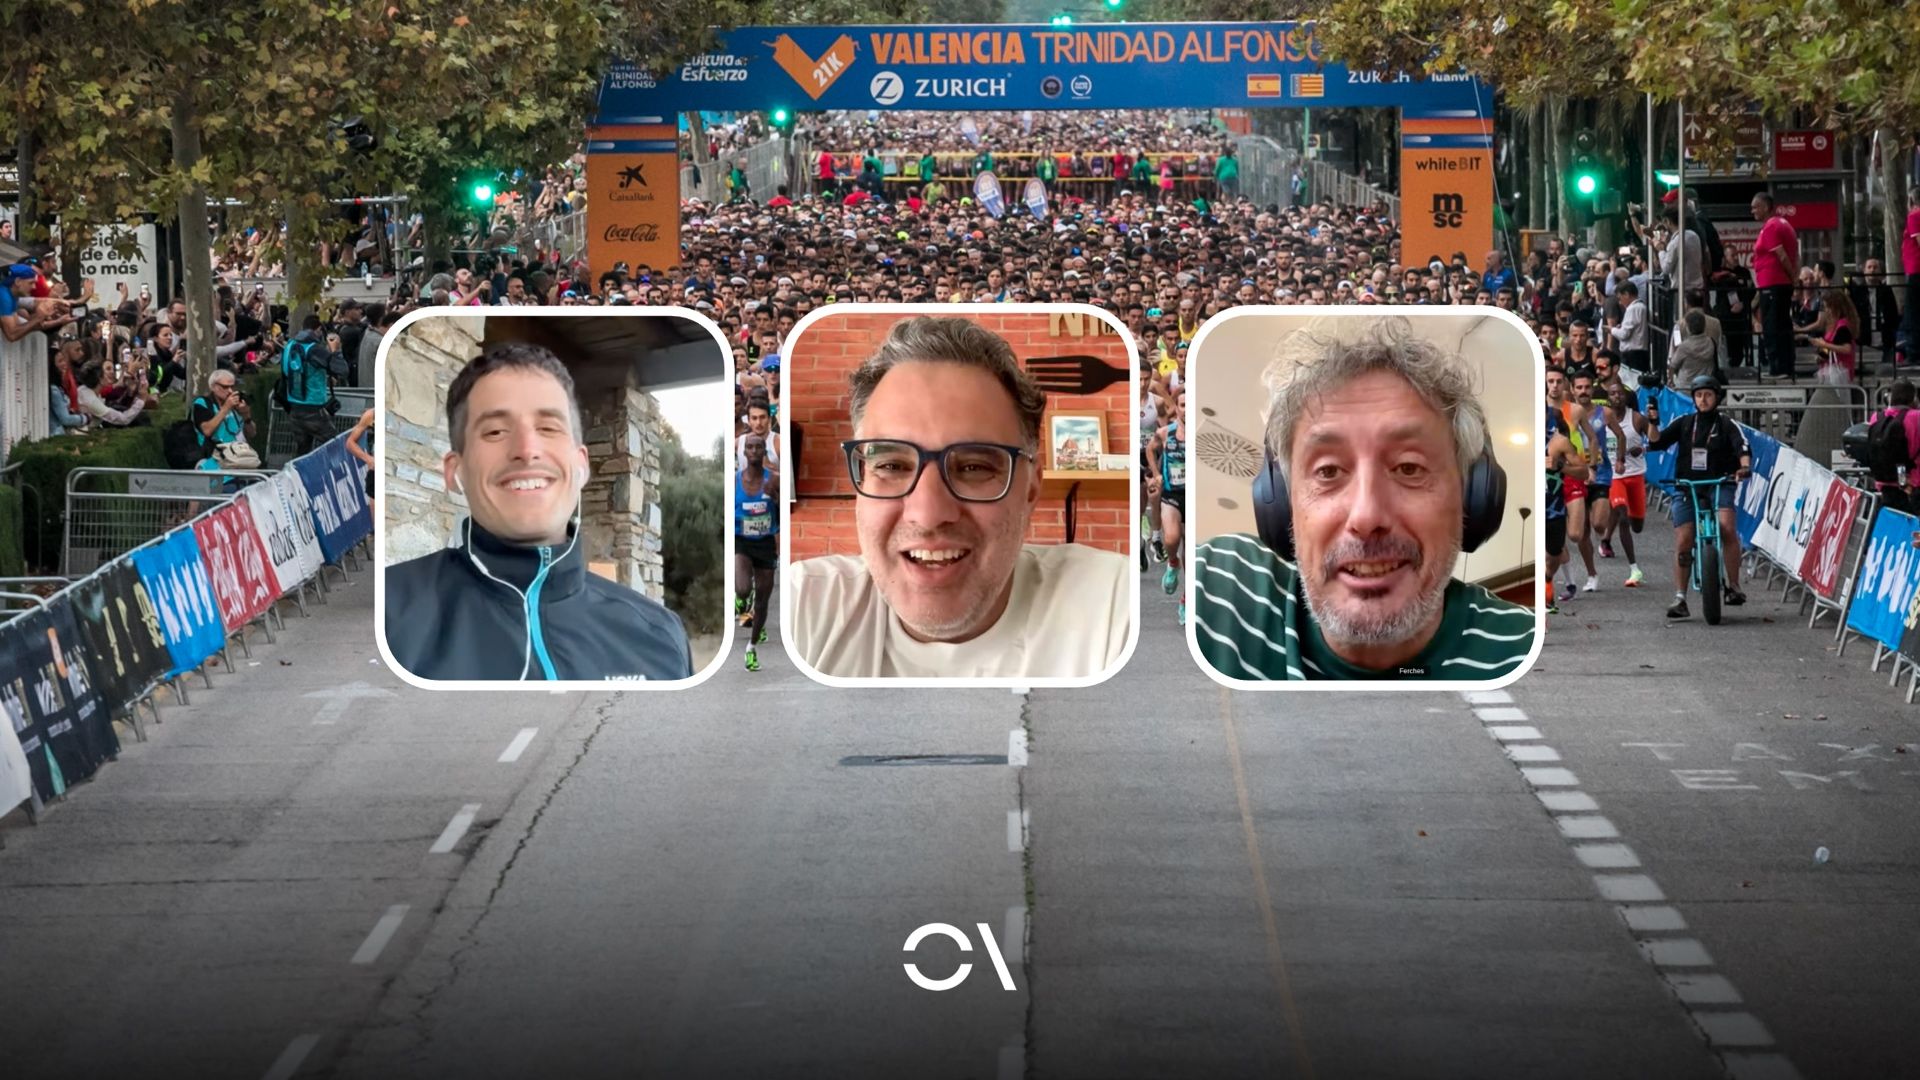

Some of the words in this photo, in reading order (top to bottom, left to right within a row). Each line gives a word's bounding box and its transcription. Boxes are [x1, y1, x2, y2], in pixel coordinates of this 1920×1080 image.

[870, 33, 1025, 64] VALENCIA
[1032, 32, 1175, 63] TRINIDAD
[610, 72, 653, 80] TRINIDA
[681, 67, 748, 81] Esfuerzo
[812, 51, 845, 88] 21K
[610, 81, 657, 89] ALFONSO
[915, 78, 1006, 97] ZURICH
[609, 192, 655, 202] CaixaBank
[101, 261, 139, 275] más
